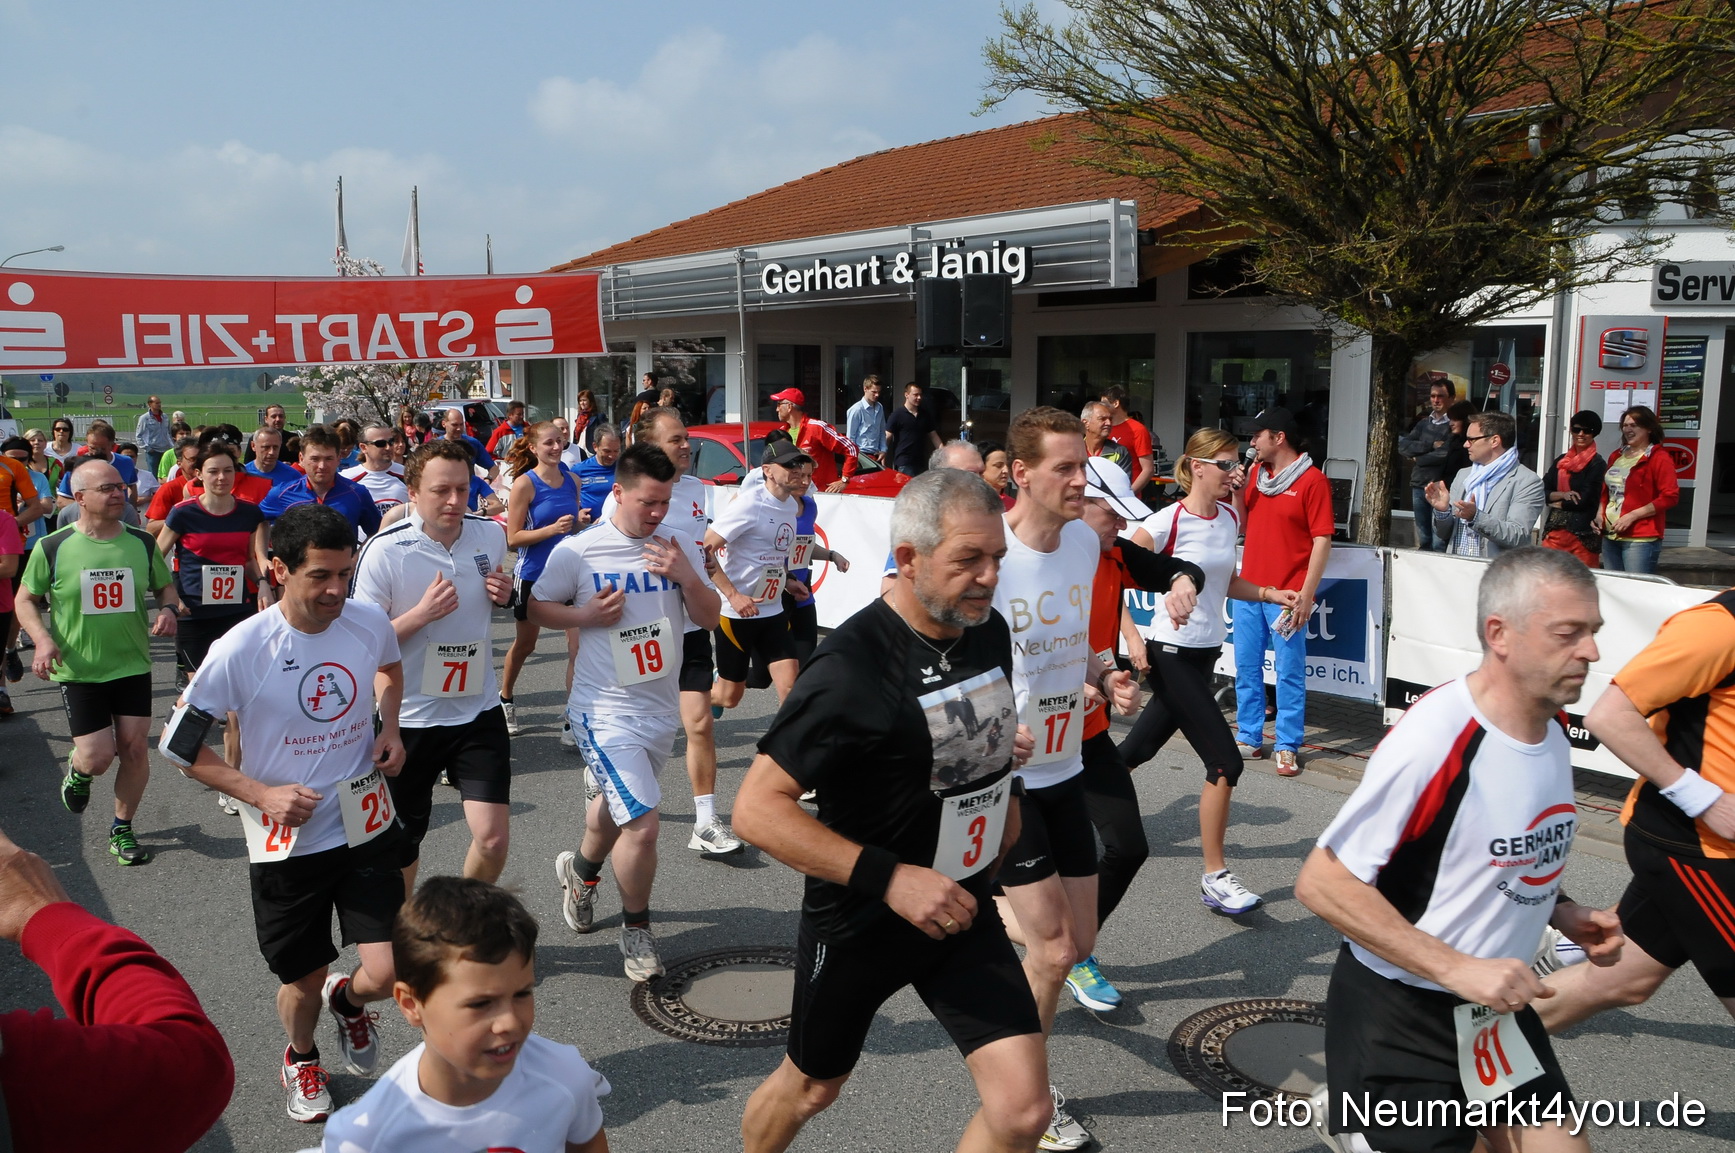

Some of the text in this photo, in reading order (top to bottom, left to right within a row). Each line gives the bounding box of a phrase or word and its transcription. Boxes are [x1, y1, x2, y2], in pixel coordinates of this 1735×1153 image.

[761, 239, 1028, 295] Gerhart & Jänig
[1590, 380, 1654, 390] SEAT
[792, 545, 807, 565] 31
[93, 581, 123, 609] 69
[211, 576, 235, 600] 92
[760, 578, 780, 600] 76
[619, 626, 648, 639] MEYER
[620, 633, 650, 643] WERBUNG
[630, 639, 663, 676] 19
[442, 661, 469, 693] 71
[1333, 663, 1364, 685] ich.
[1038, 695, 1068, 707] MEYER
[1038, 704, 1068, 713] WERBUNG
[285, 735, 325, 745] LAUFEN
[1044, 711, 1071, 754] 17
[307, 747, 325, 755] Heck
[361, 782, 391, 834] 23
[957, 790, 994, 810] MEYER
[261, 812, 293, 852] 24
[962, 815, 987, 868] 3
[1489, 819, 1574, 857] GERHART
[1473, 1019, 1514, 1087] 81
